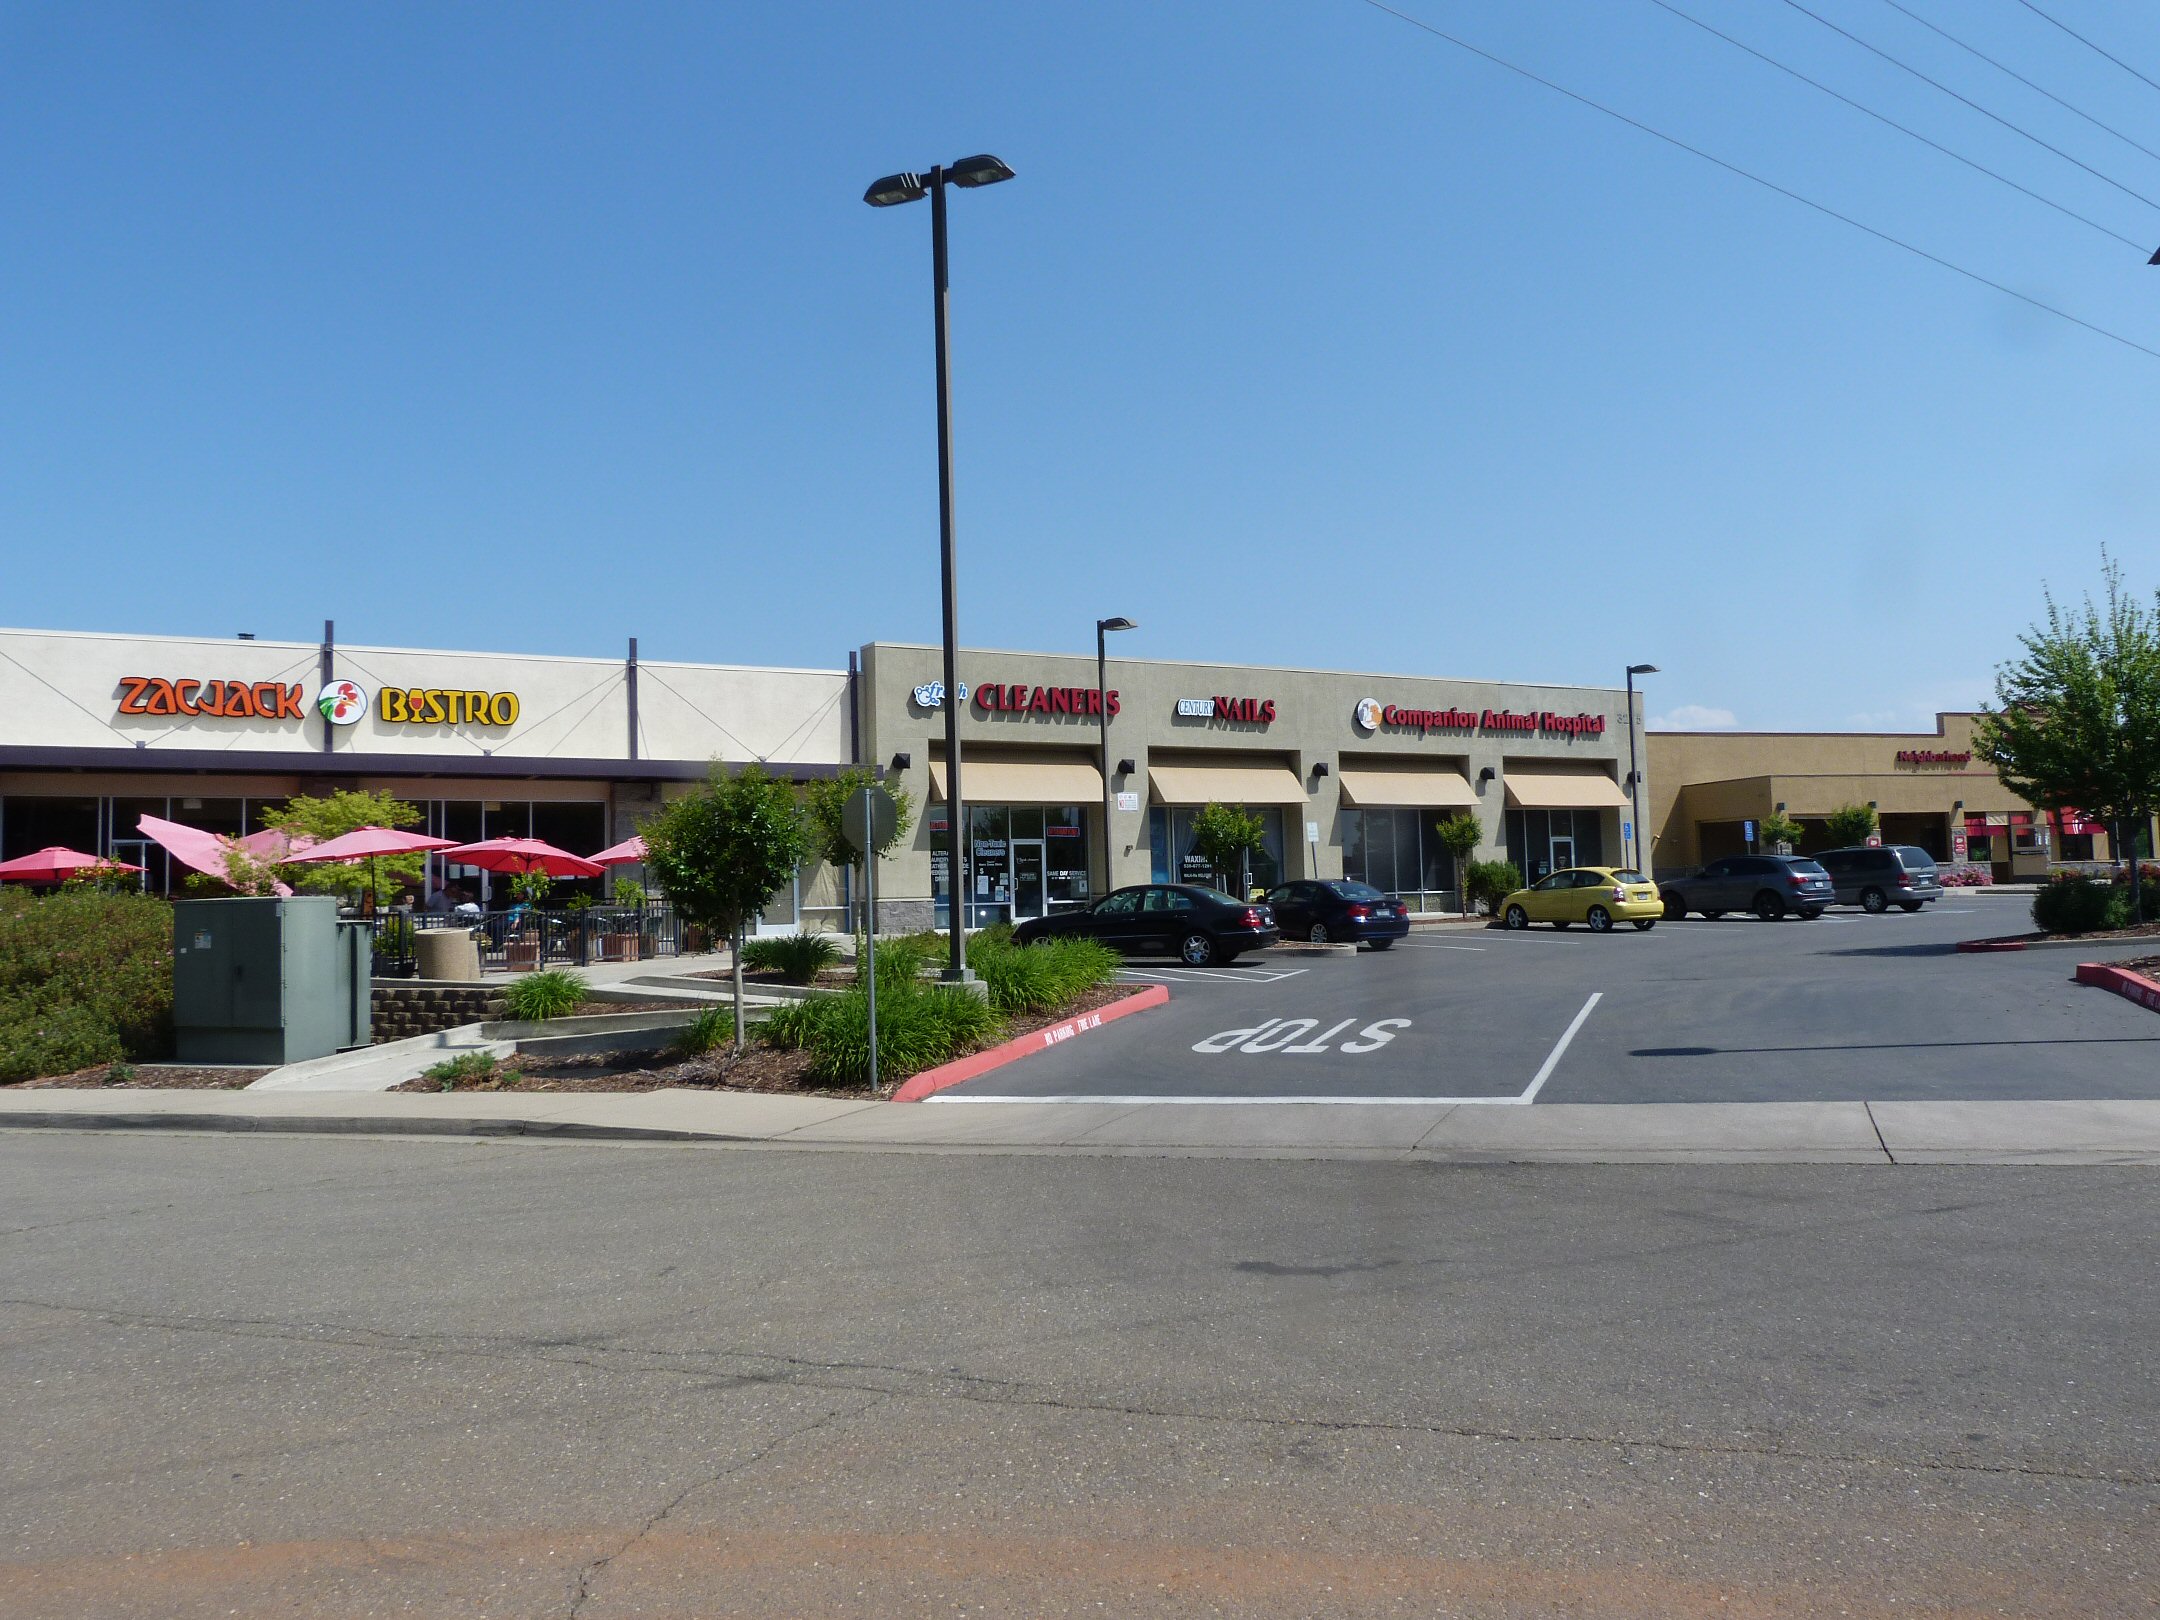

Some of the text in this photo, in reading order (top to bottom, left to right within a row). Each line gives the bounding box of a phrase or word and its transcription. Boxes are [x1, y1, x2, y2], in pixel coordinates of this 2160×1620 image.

[119, 677, 520, 726] ZACJACK BISTRO
[930, 681, 1120, 715] frh CLEANERS
[1178, 696, 1276, 723] CENTURY NAILS
[1385, 704, 1478, 732] Companion
[1483, 709, 1539, 729] Animal
[1544, 711, 1605, 736] Hospital
[1044, 1014, 1102, 1046] NO PARKING FIRE LANE
[1191, 1017, 1412, 1053] STOP
